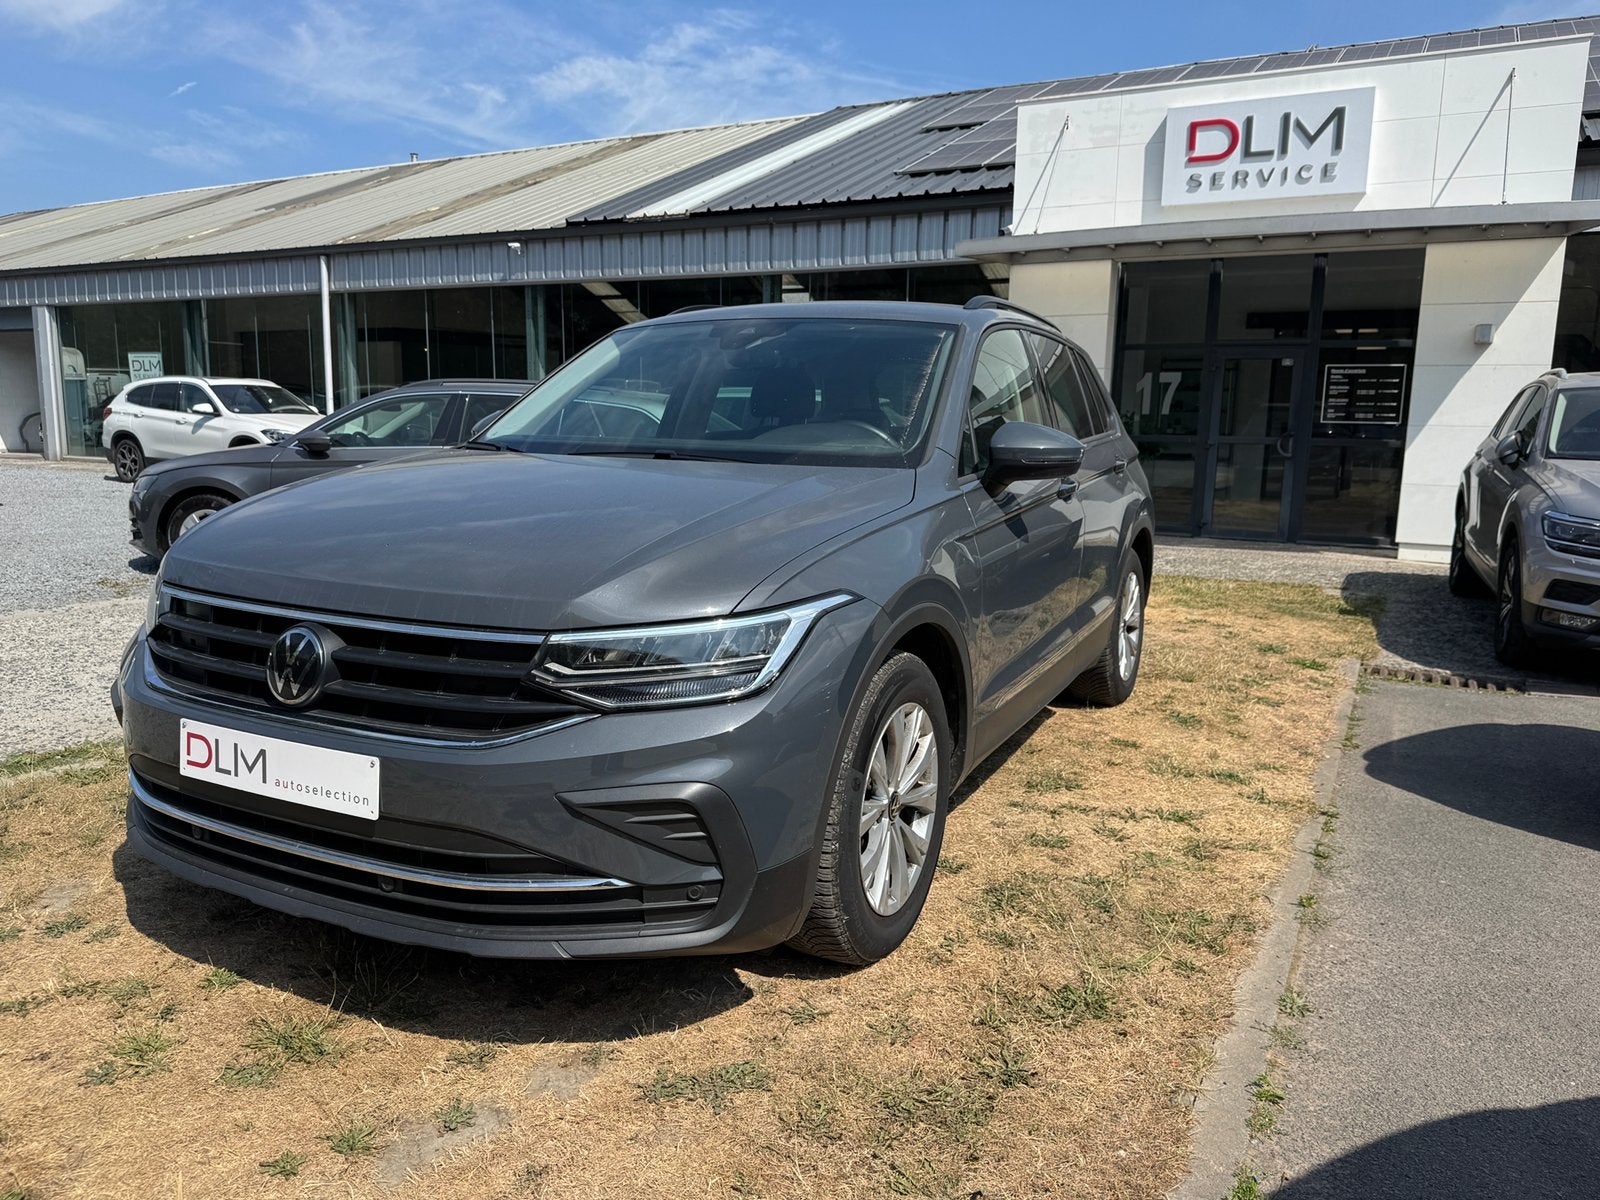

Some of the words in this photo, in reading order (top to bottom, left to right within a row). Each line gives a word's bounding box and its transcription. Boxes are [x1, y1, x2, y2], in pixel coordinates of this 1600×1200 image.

[1187, 106, 1346, 163] DLM
[1187, 162, 1338, 190] SERVICE
[132, 359, 162, 372] DLM
[1136, 372, 1182, 415] 17
[187, 731, 267, 784] DLM
[275, 777, 369, 806] autoselection
